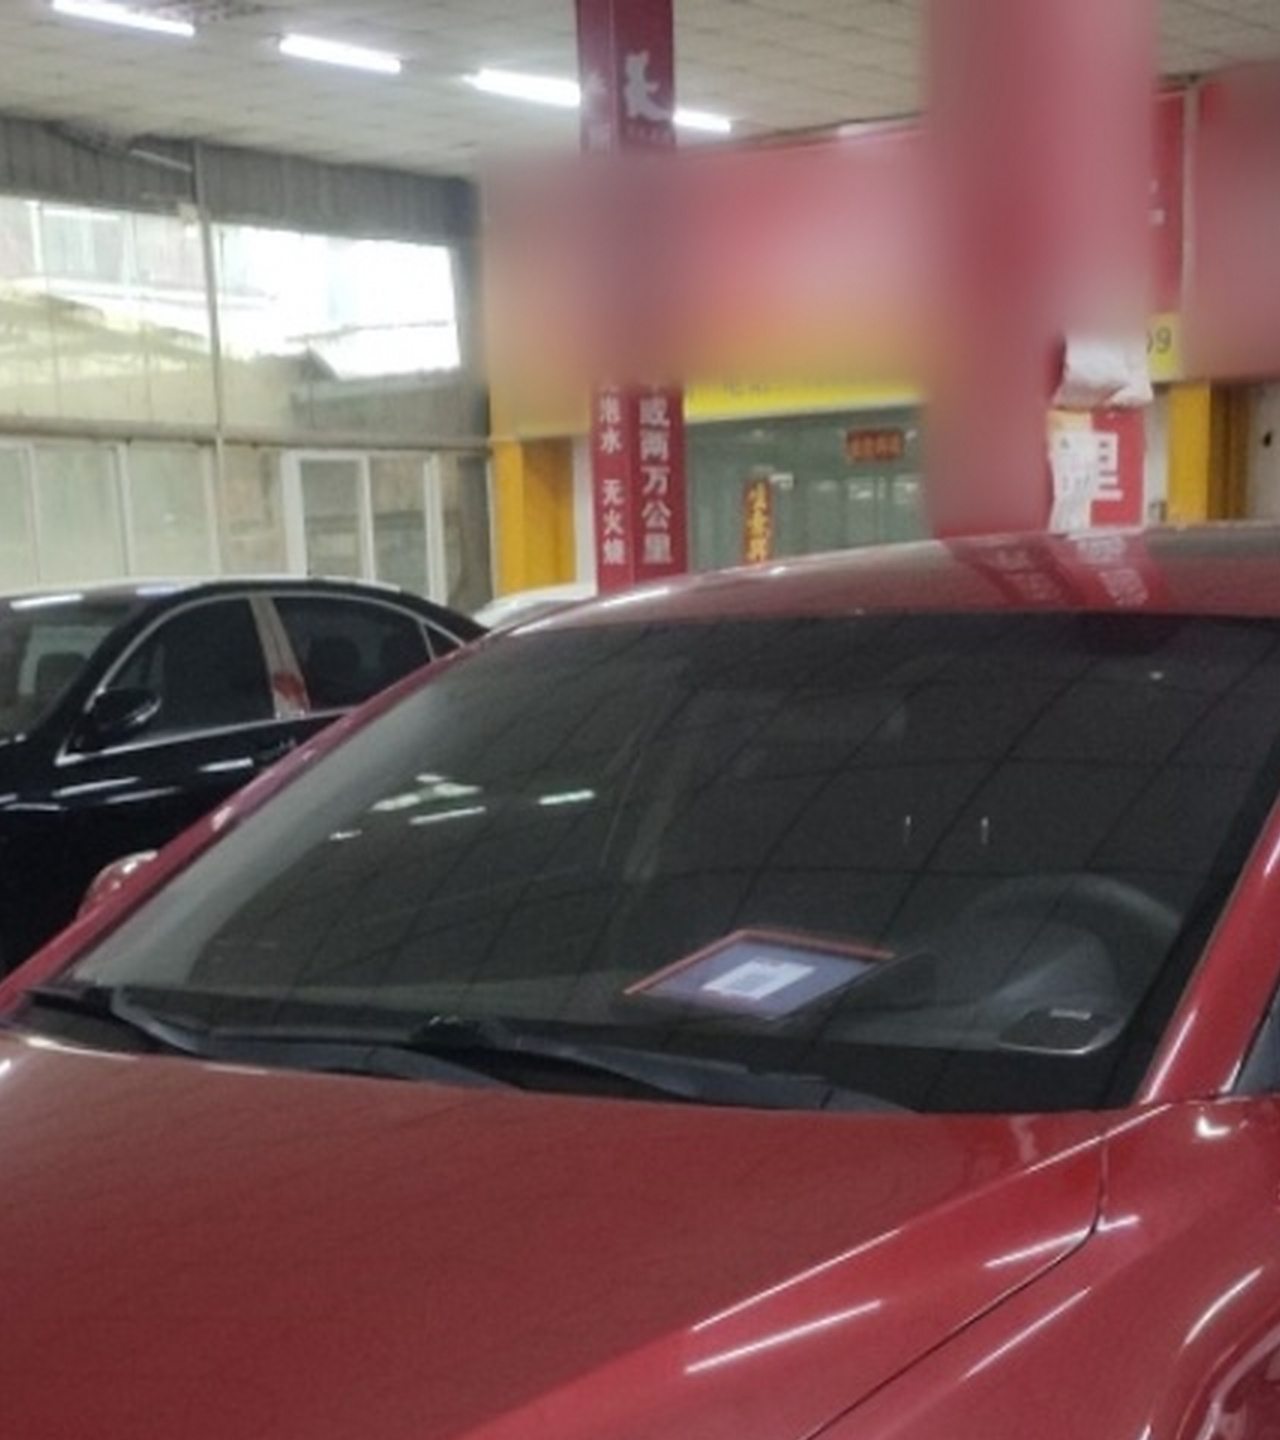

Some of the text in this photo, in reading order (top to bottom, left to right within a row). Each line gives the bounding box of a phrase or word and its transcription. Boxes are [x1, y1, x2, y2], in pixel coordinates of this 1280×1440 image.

[639, 384, 674, 565] 或两万公里
